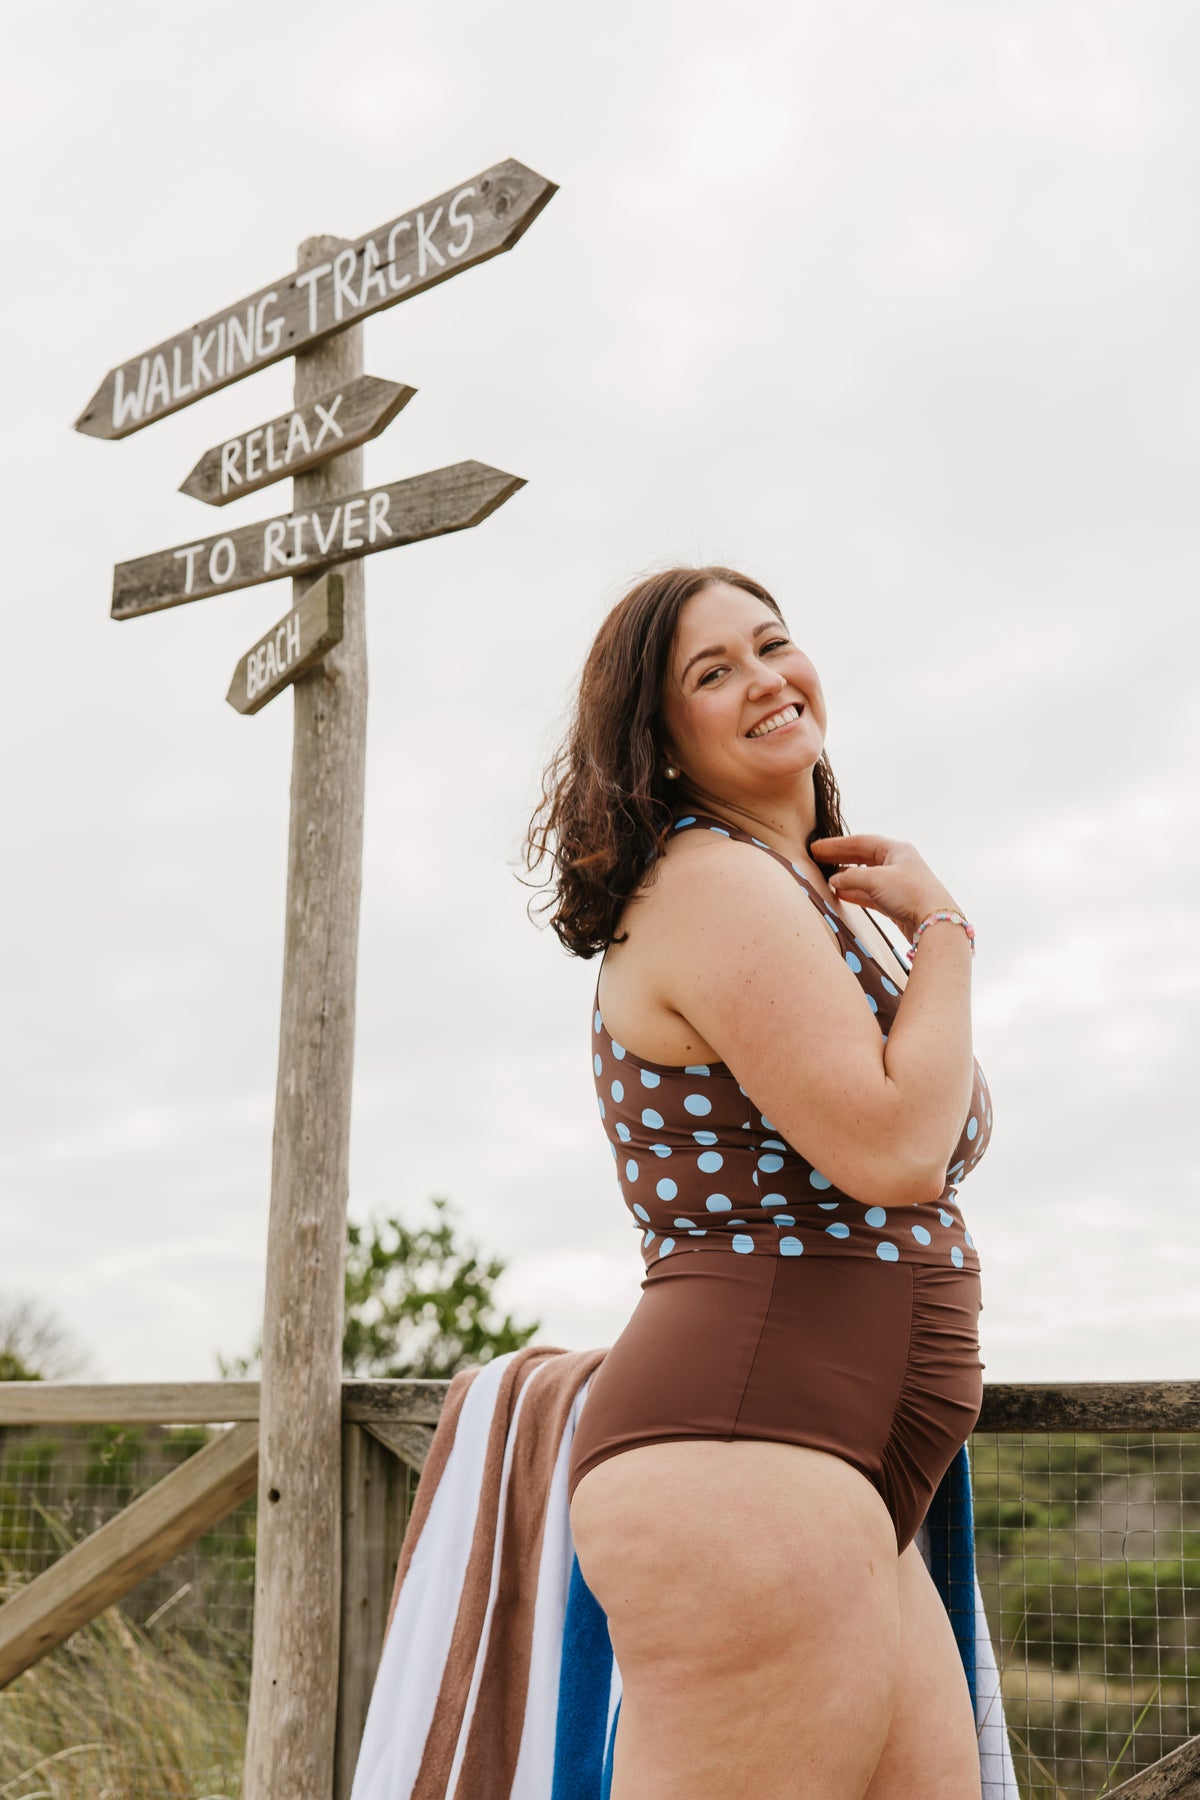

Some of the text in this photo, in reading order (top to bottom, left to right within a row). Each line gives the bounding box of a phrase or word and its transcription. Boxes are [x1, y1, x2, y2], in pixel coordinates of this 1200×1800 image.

[112, 187, 476, 428] WALKING TRACKS
[221, 394, 344, 495] RELAX
[173, 492, 393, 594] TO RIVER
[246, 613, 301, 700] BEACH
